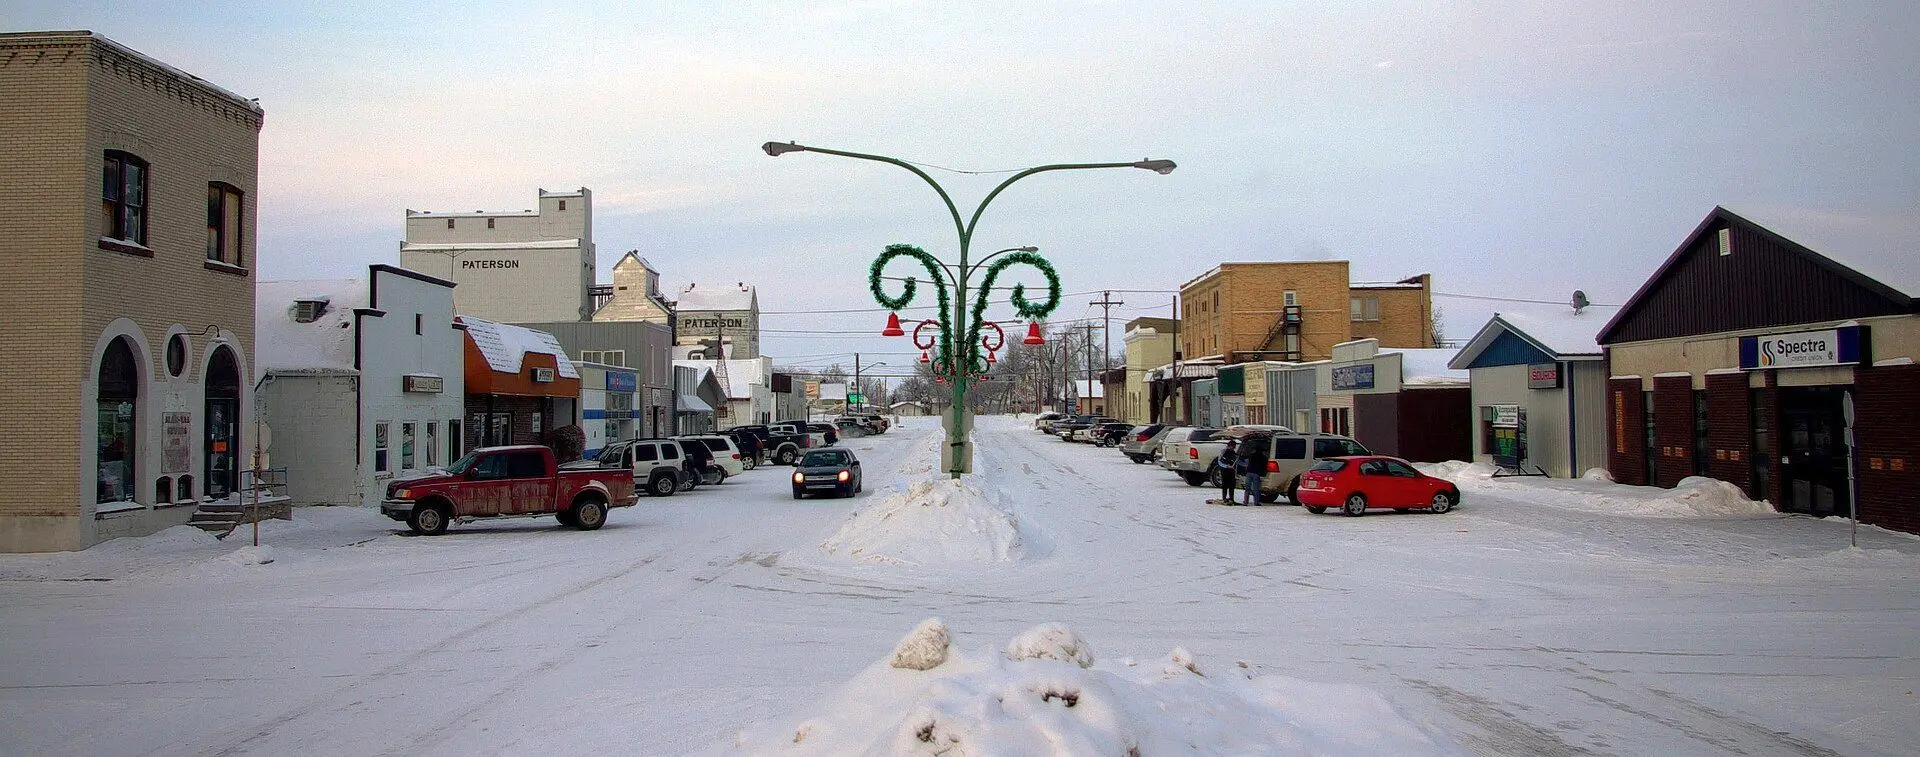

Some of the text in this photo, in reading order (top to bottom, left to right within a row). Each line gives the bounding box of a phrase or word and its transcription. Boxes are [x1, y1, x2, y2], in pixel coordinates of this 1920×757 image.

[462, 260, 519, 269] PATERSON
[684, 318, 742, 329] PATERSON
[1777, 339, 1826, 357] Spectra
